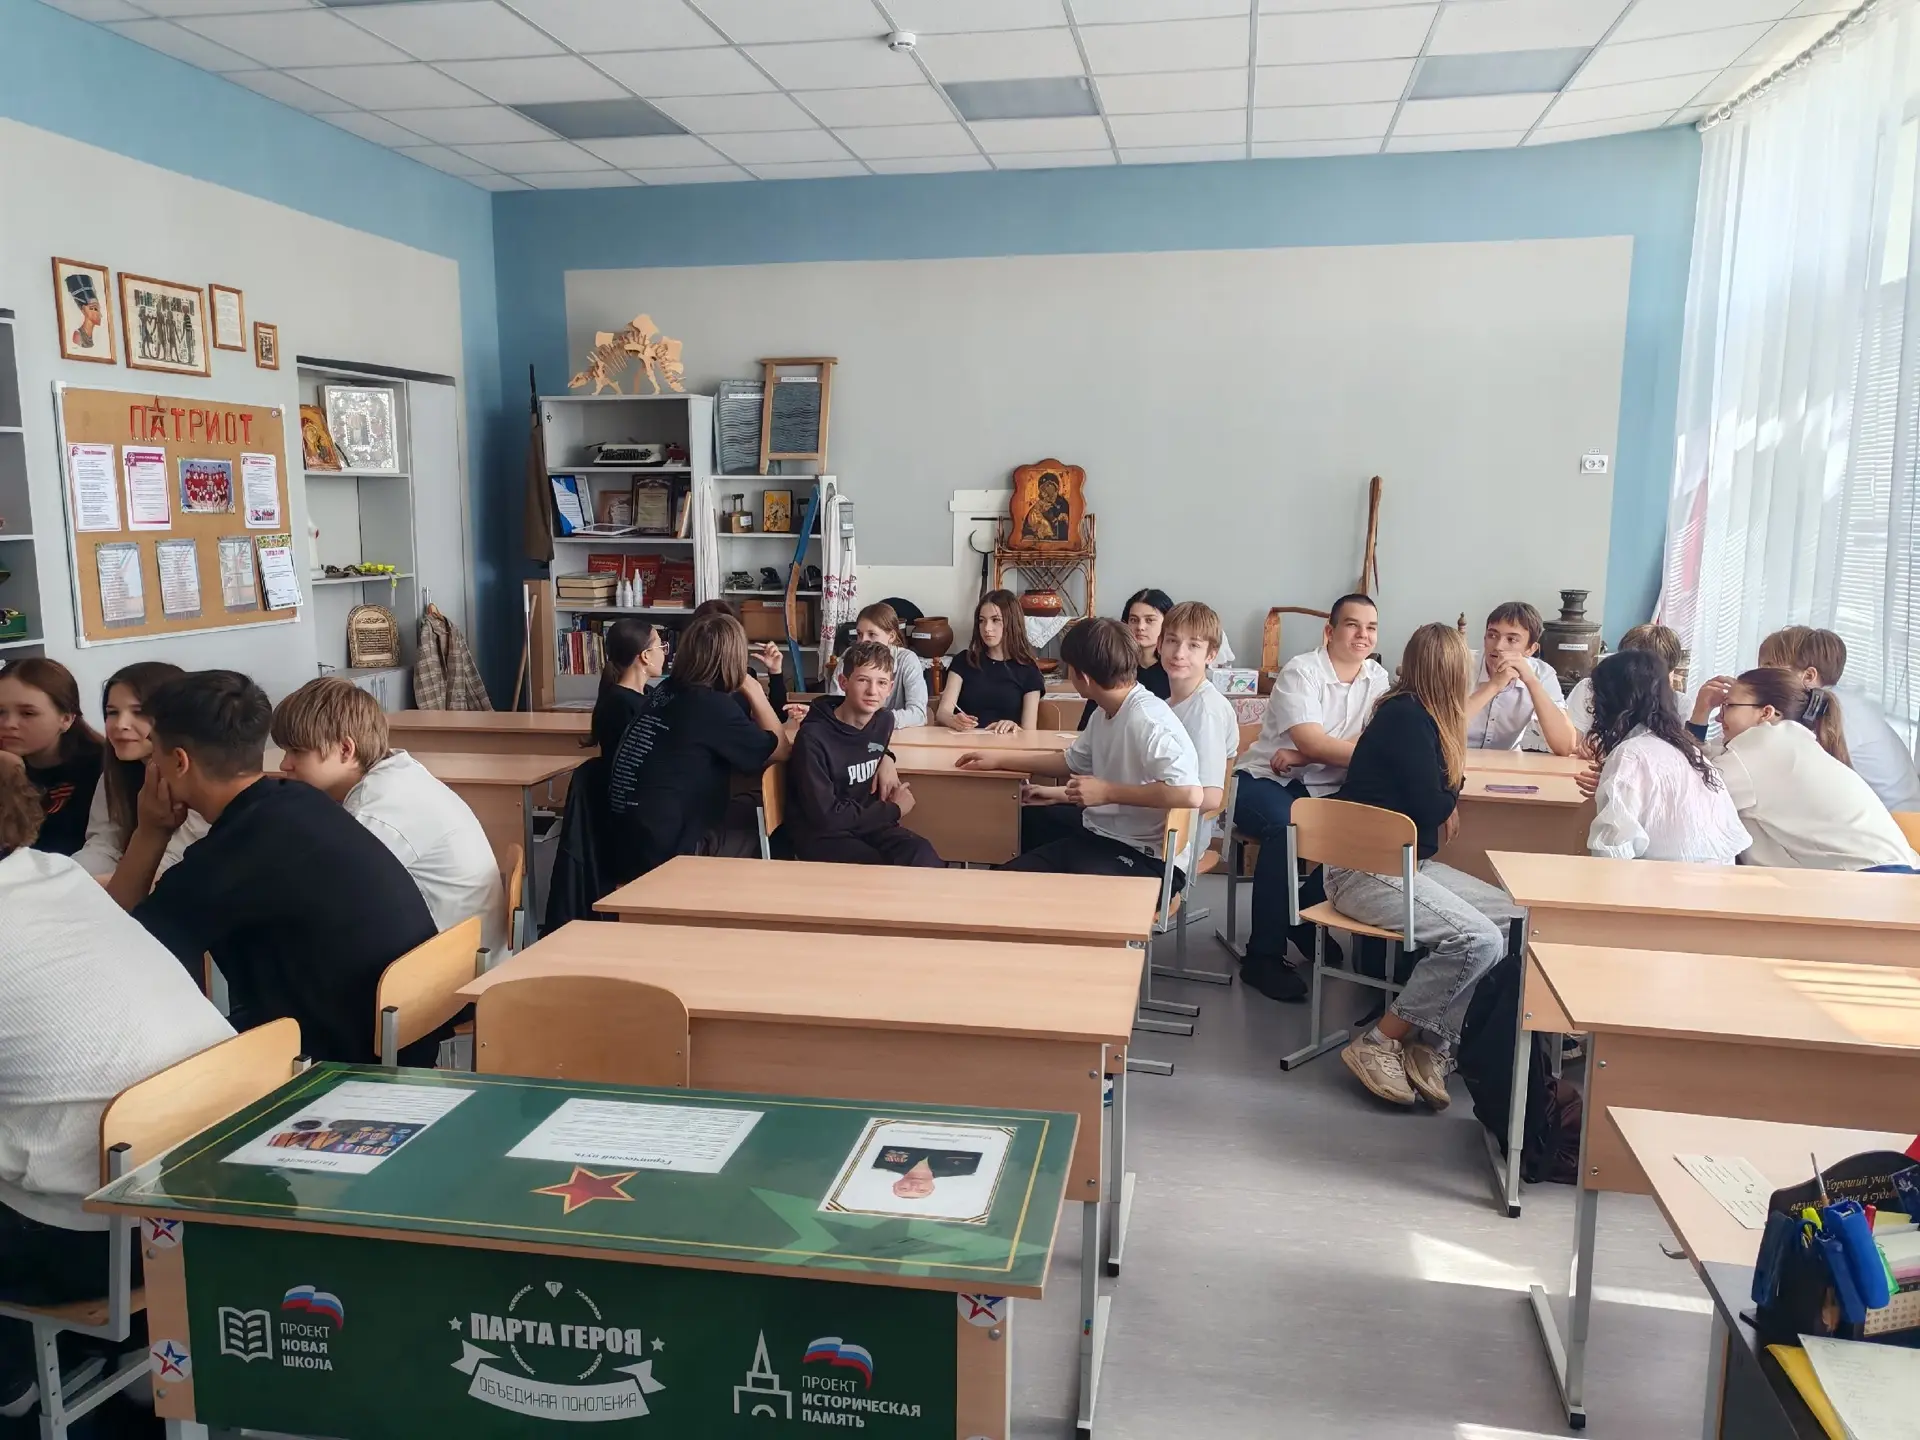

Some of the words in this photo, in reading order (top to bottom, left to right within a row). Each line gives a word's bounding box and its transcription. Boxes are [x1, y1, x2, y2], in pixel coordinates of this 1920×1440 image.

[130, 400, 253, 445] ПАТРИОТ
[847, 756, 881, 785] PUM
[280, 1322, 330, 1339] ПРОЕКТ
[471, 1312, 556, 1346] ПАРТА
[560, 1324, 642, 1356] ГЕРОЯ
[281, 1338, 328, 1354] НОВАЯ
[282, 1355, 333, 1371] ШКОЛА
[802, 1375, 858, 1393] ПРОЕКТ
[802, 1392, 921, 1418] ИСТОРИЧЕСКАЯ
[802, 1409, 865, 1428] ПАМЯТЬ
